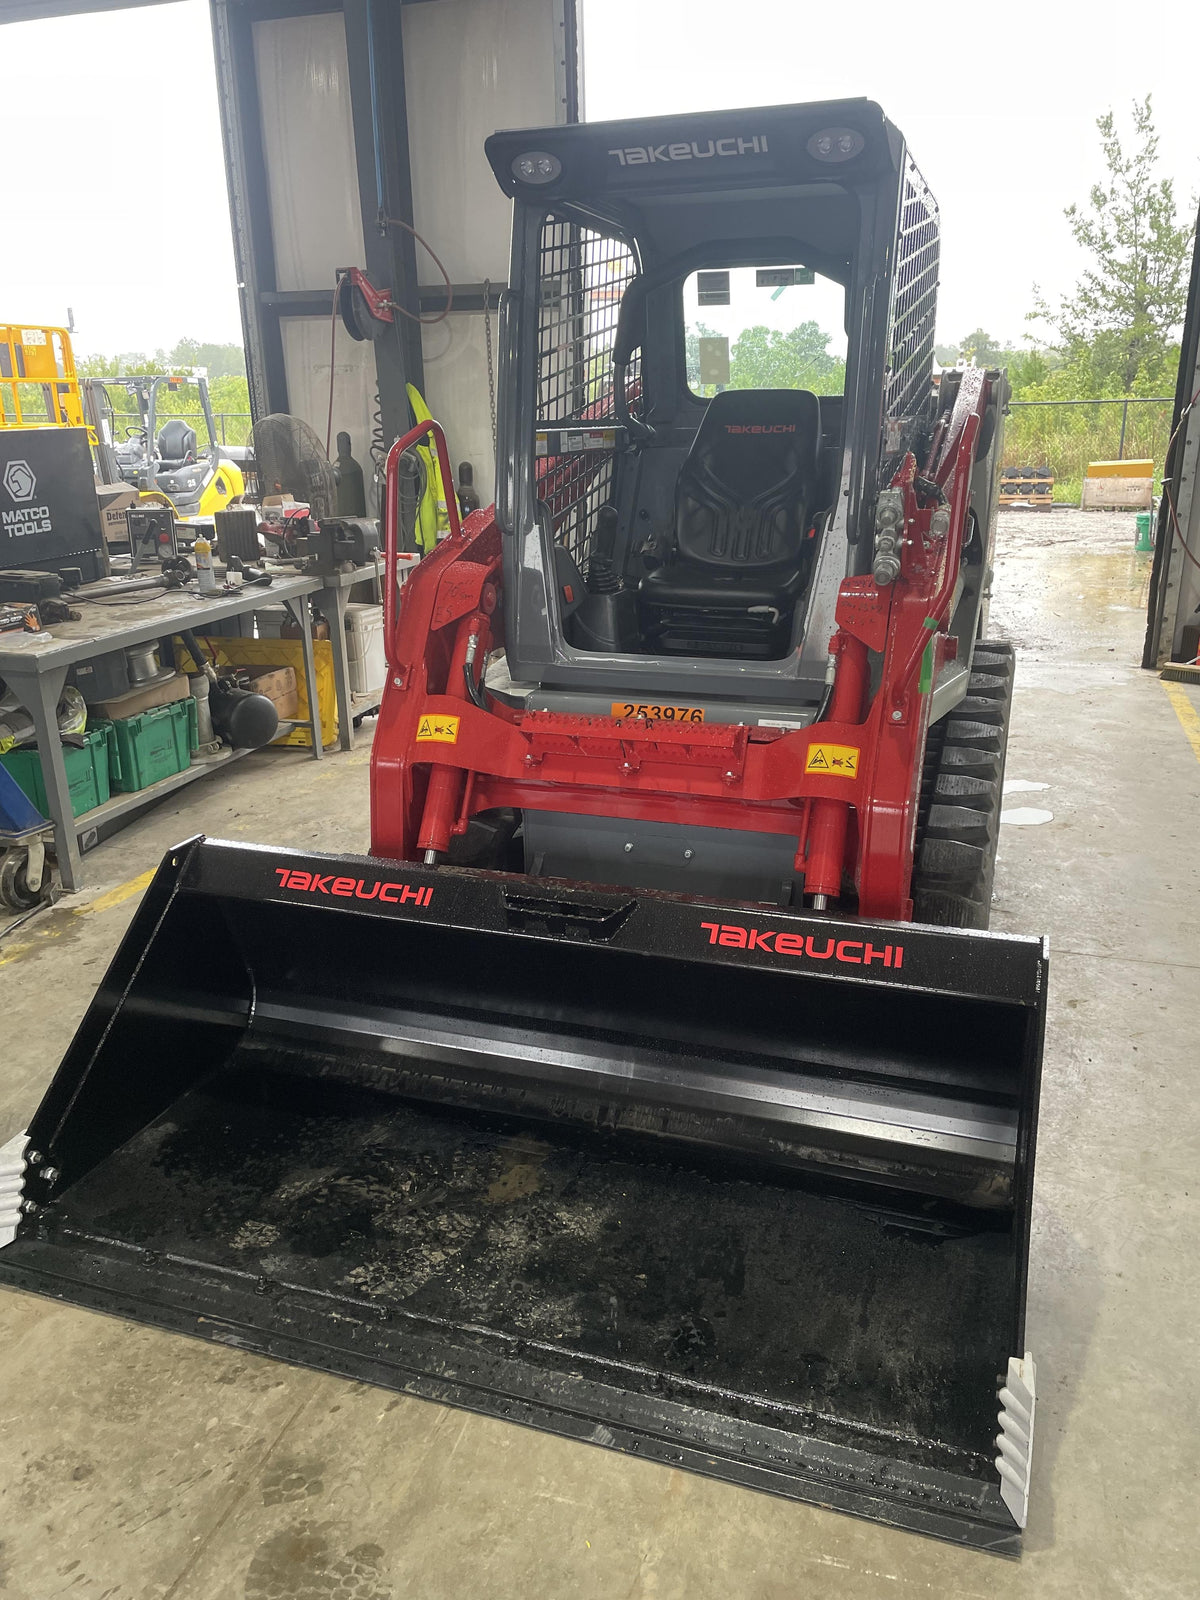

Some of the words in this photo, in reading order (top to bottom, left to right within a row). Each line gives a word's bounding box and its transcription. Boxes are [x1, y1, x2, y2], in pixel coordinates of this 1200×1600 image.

[608, 135, 769, 166] TAKEUCHI
[724, 424, 796, 434] TAKEUCHI
[2, 506, 50, 524] MATCO
[4, 519, 52, 538] TOOLS
[623, 704, 703, 723] 253976
[275, 868, 434, 907] TAKEUCHI
[700, 922, 904, 969] TAKEUCHI
